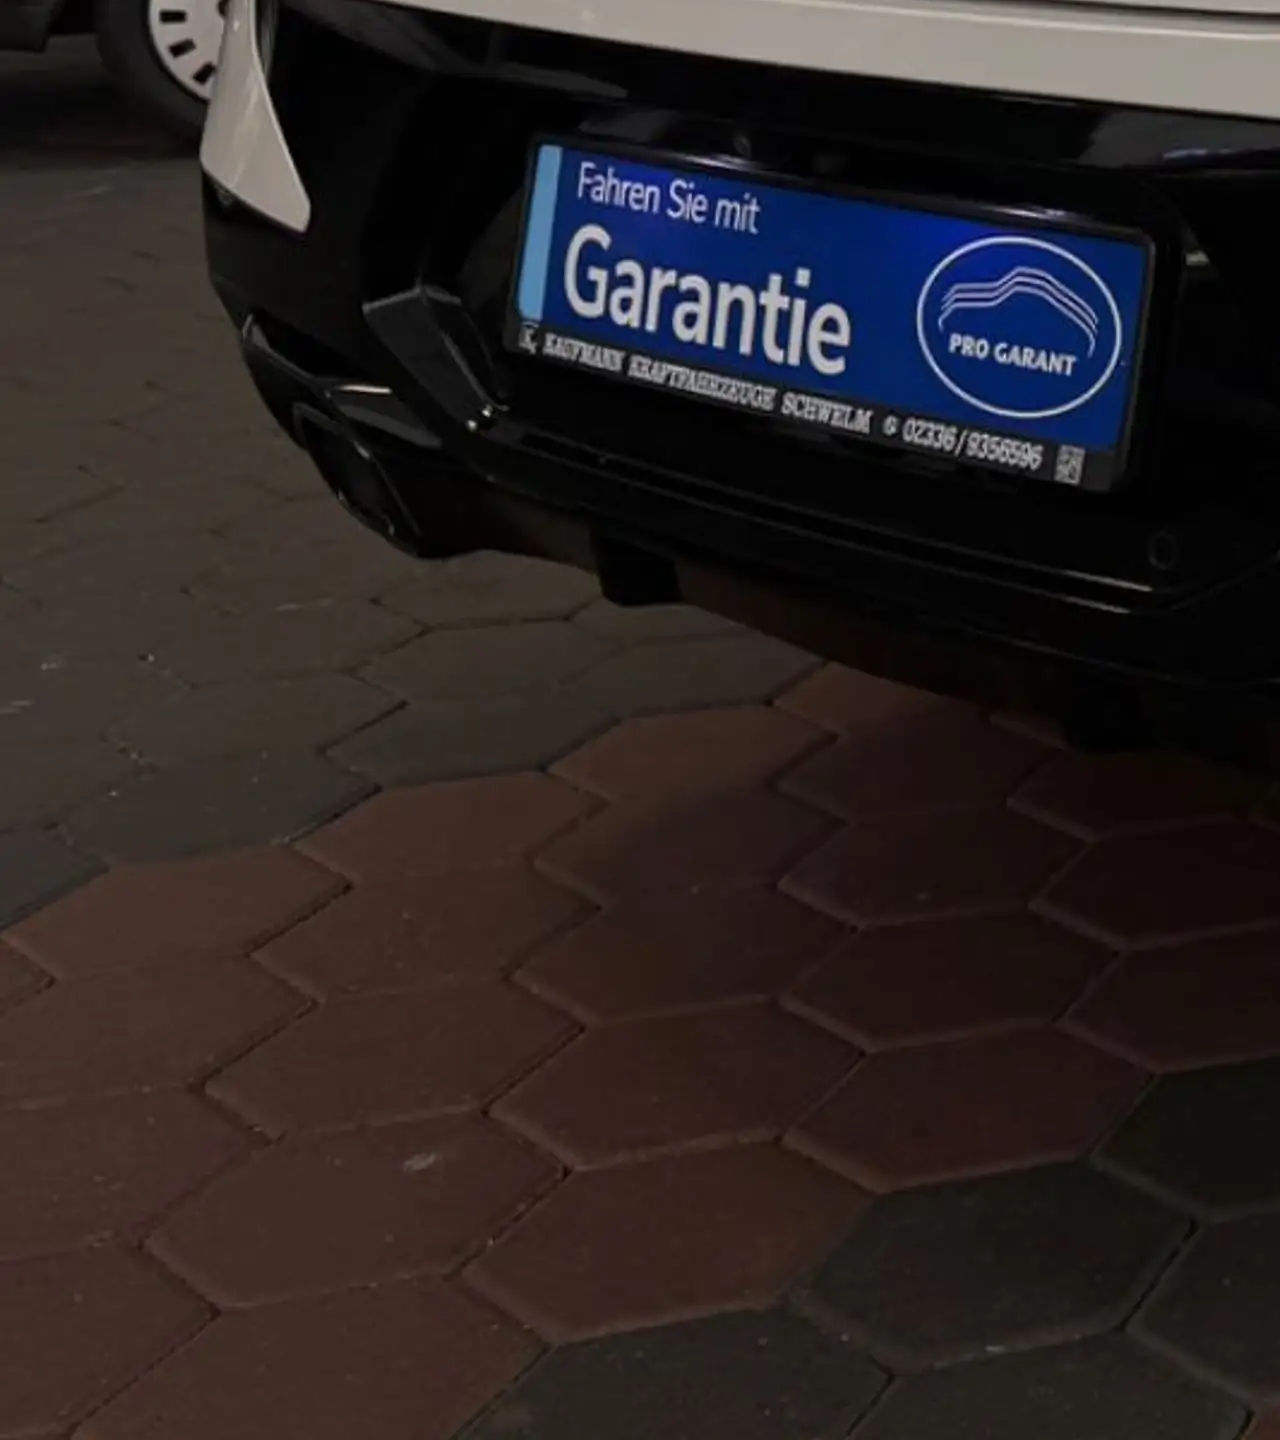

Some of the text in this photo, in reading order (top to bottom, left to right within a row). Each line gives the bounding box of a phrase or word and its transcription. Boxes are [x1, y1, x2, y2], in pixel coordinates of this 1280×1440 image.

[578, 160, 761, 235] Fahren Sie mit
[563, 224, 851, 377] Garantie
[948, 333, 1078, 377] PRO GARANT
[781, 392, 874, 435] SCHWELM
